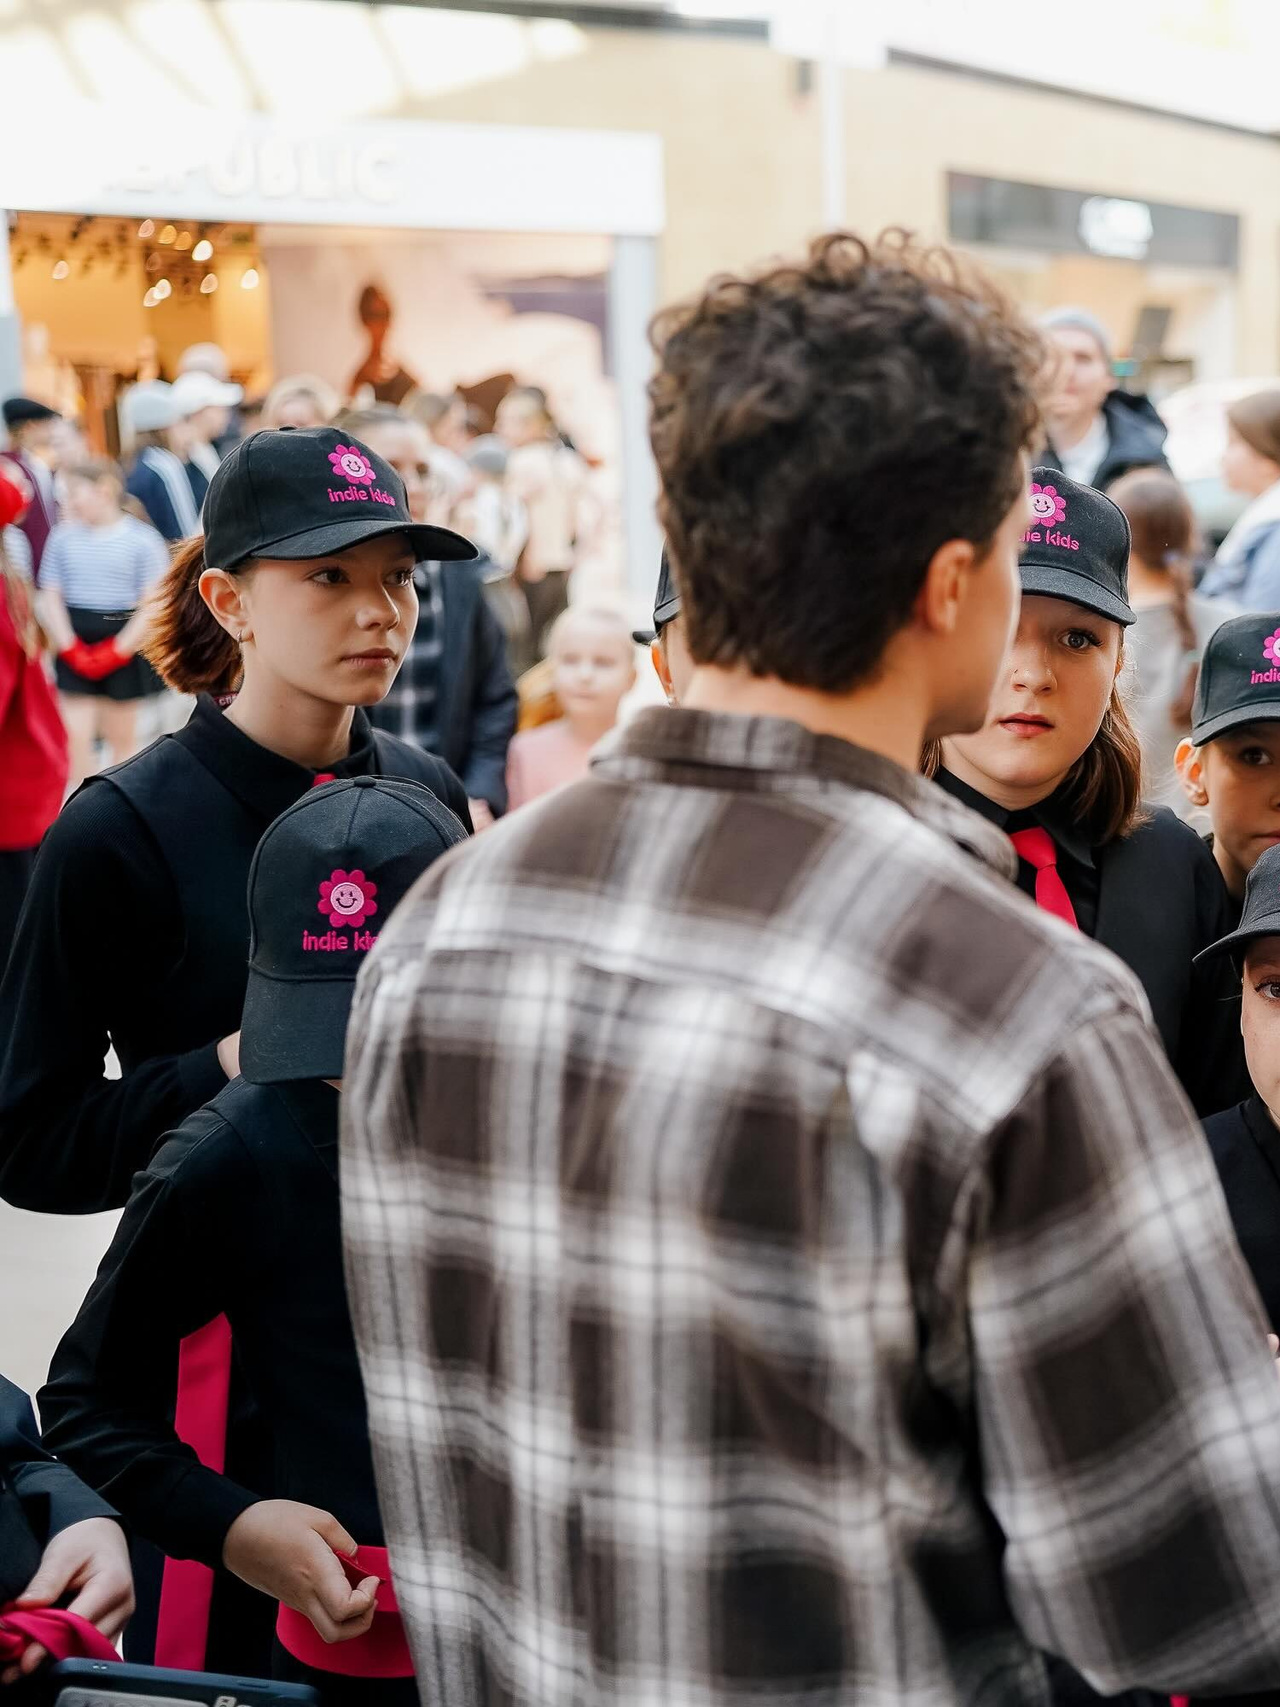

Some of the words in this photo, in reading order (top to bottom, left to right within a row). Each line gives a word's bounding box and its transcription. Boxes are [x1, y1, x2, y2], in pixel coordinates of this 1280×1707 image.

[327, 486, 369, 503] indie
[369, 487, 396, 507] kids
[1045, 529, 1080, 551] kids
[302, 929, 349, 951] indie
